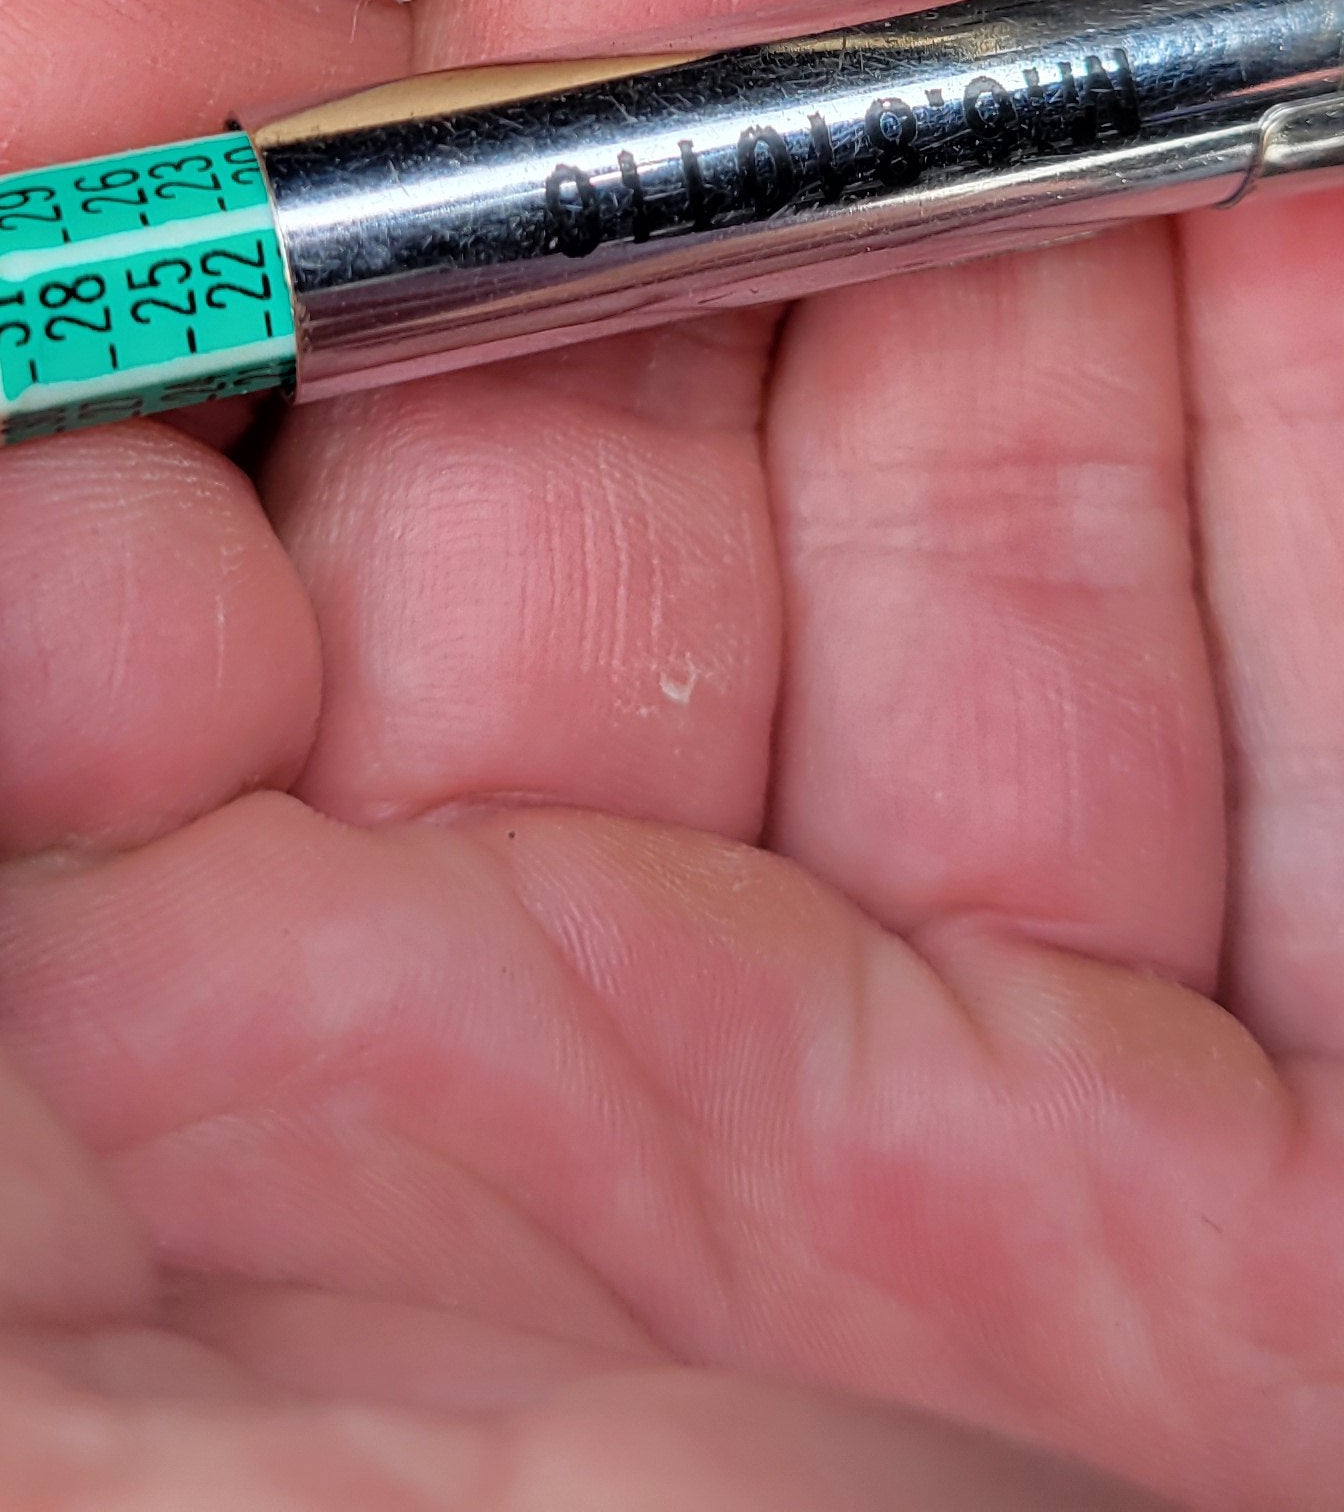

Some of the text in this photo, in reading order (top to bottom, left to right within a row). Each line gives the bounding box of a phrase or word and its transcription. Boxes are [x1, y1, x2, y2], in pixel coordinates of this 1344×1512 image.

[74, 168, 149, 214] 26
[149, 155, 222, 200] 23
[39, 273, 112, 341] 28
[127, 258, 197, 325] 25
[201, 240, 272, 309] 22
